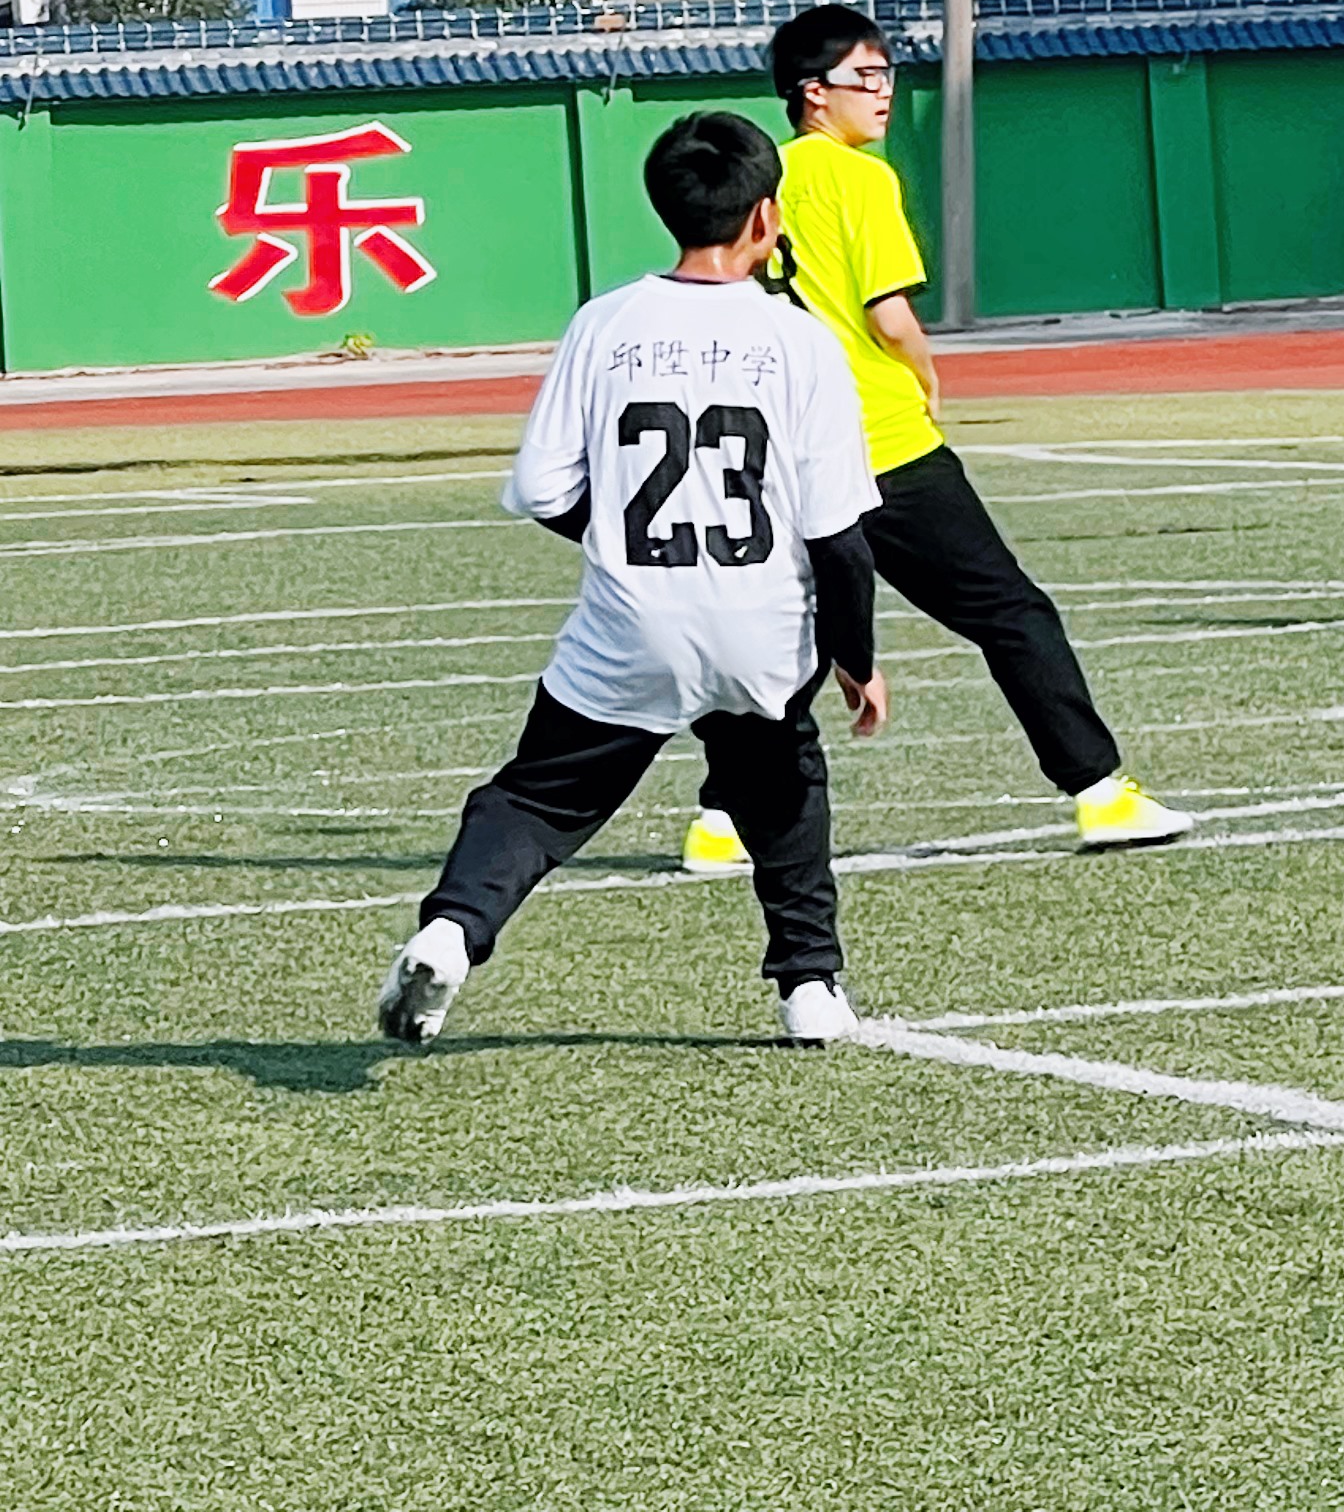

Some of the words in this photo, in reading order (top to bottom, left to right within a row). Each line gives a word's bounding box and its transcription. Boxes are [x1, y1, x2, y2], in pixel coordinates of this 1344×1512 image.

[207, 120, 438, 316] 乐
[608, 339, 777, 387] 邱陞中学
[618, 401, 774, 568] 23
